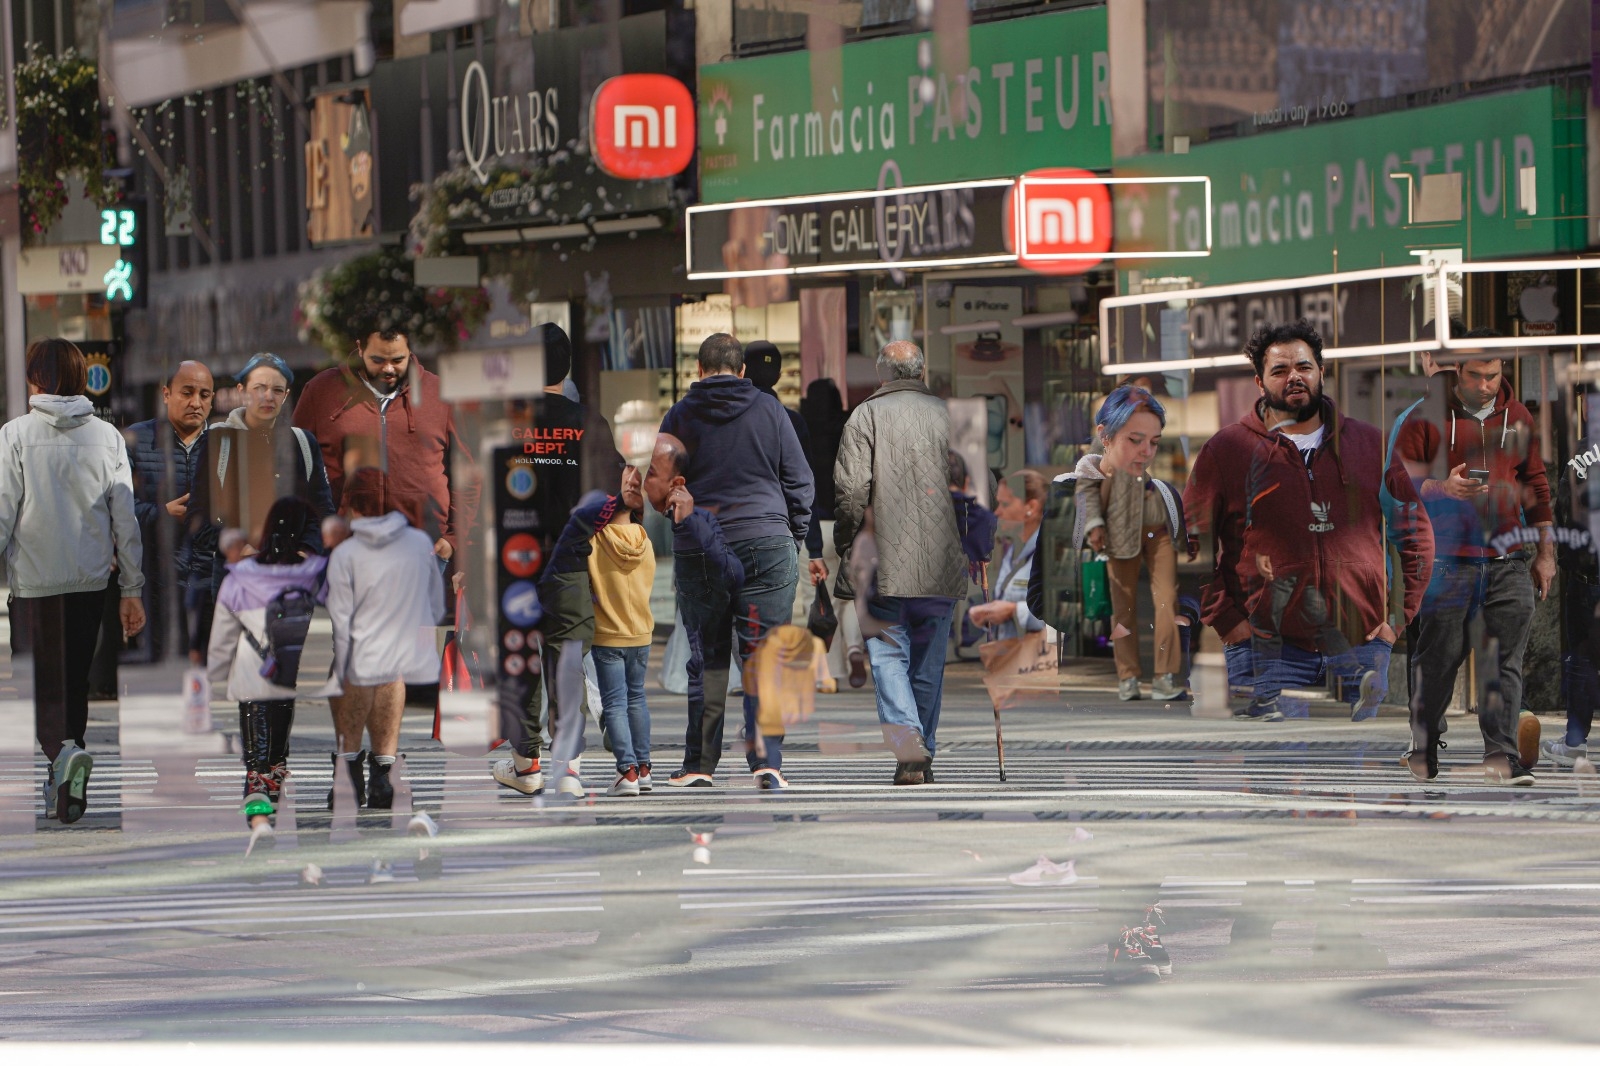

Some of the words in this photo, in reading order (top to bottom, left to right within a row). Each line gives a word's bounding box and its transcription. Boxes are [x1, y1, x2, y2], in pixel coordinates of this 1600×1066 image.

[461, 60, 560, 185] QUARS
[753, 81, 895, 162] Farmàcia
[908, 51, 1113, 145] PASTEUR
[101, 209, 135, 246] 22
[830, 201, 928, 253] GALLERY
[1167, 169, 1314, 252] Famàcia
[1181, 302, 1238, 349] OME
[512, 427, 584, 440] GALLERY
[523, 442, 567, 454] DEPT.
